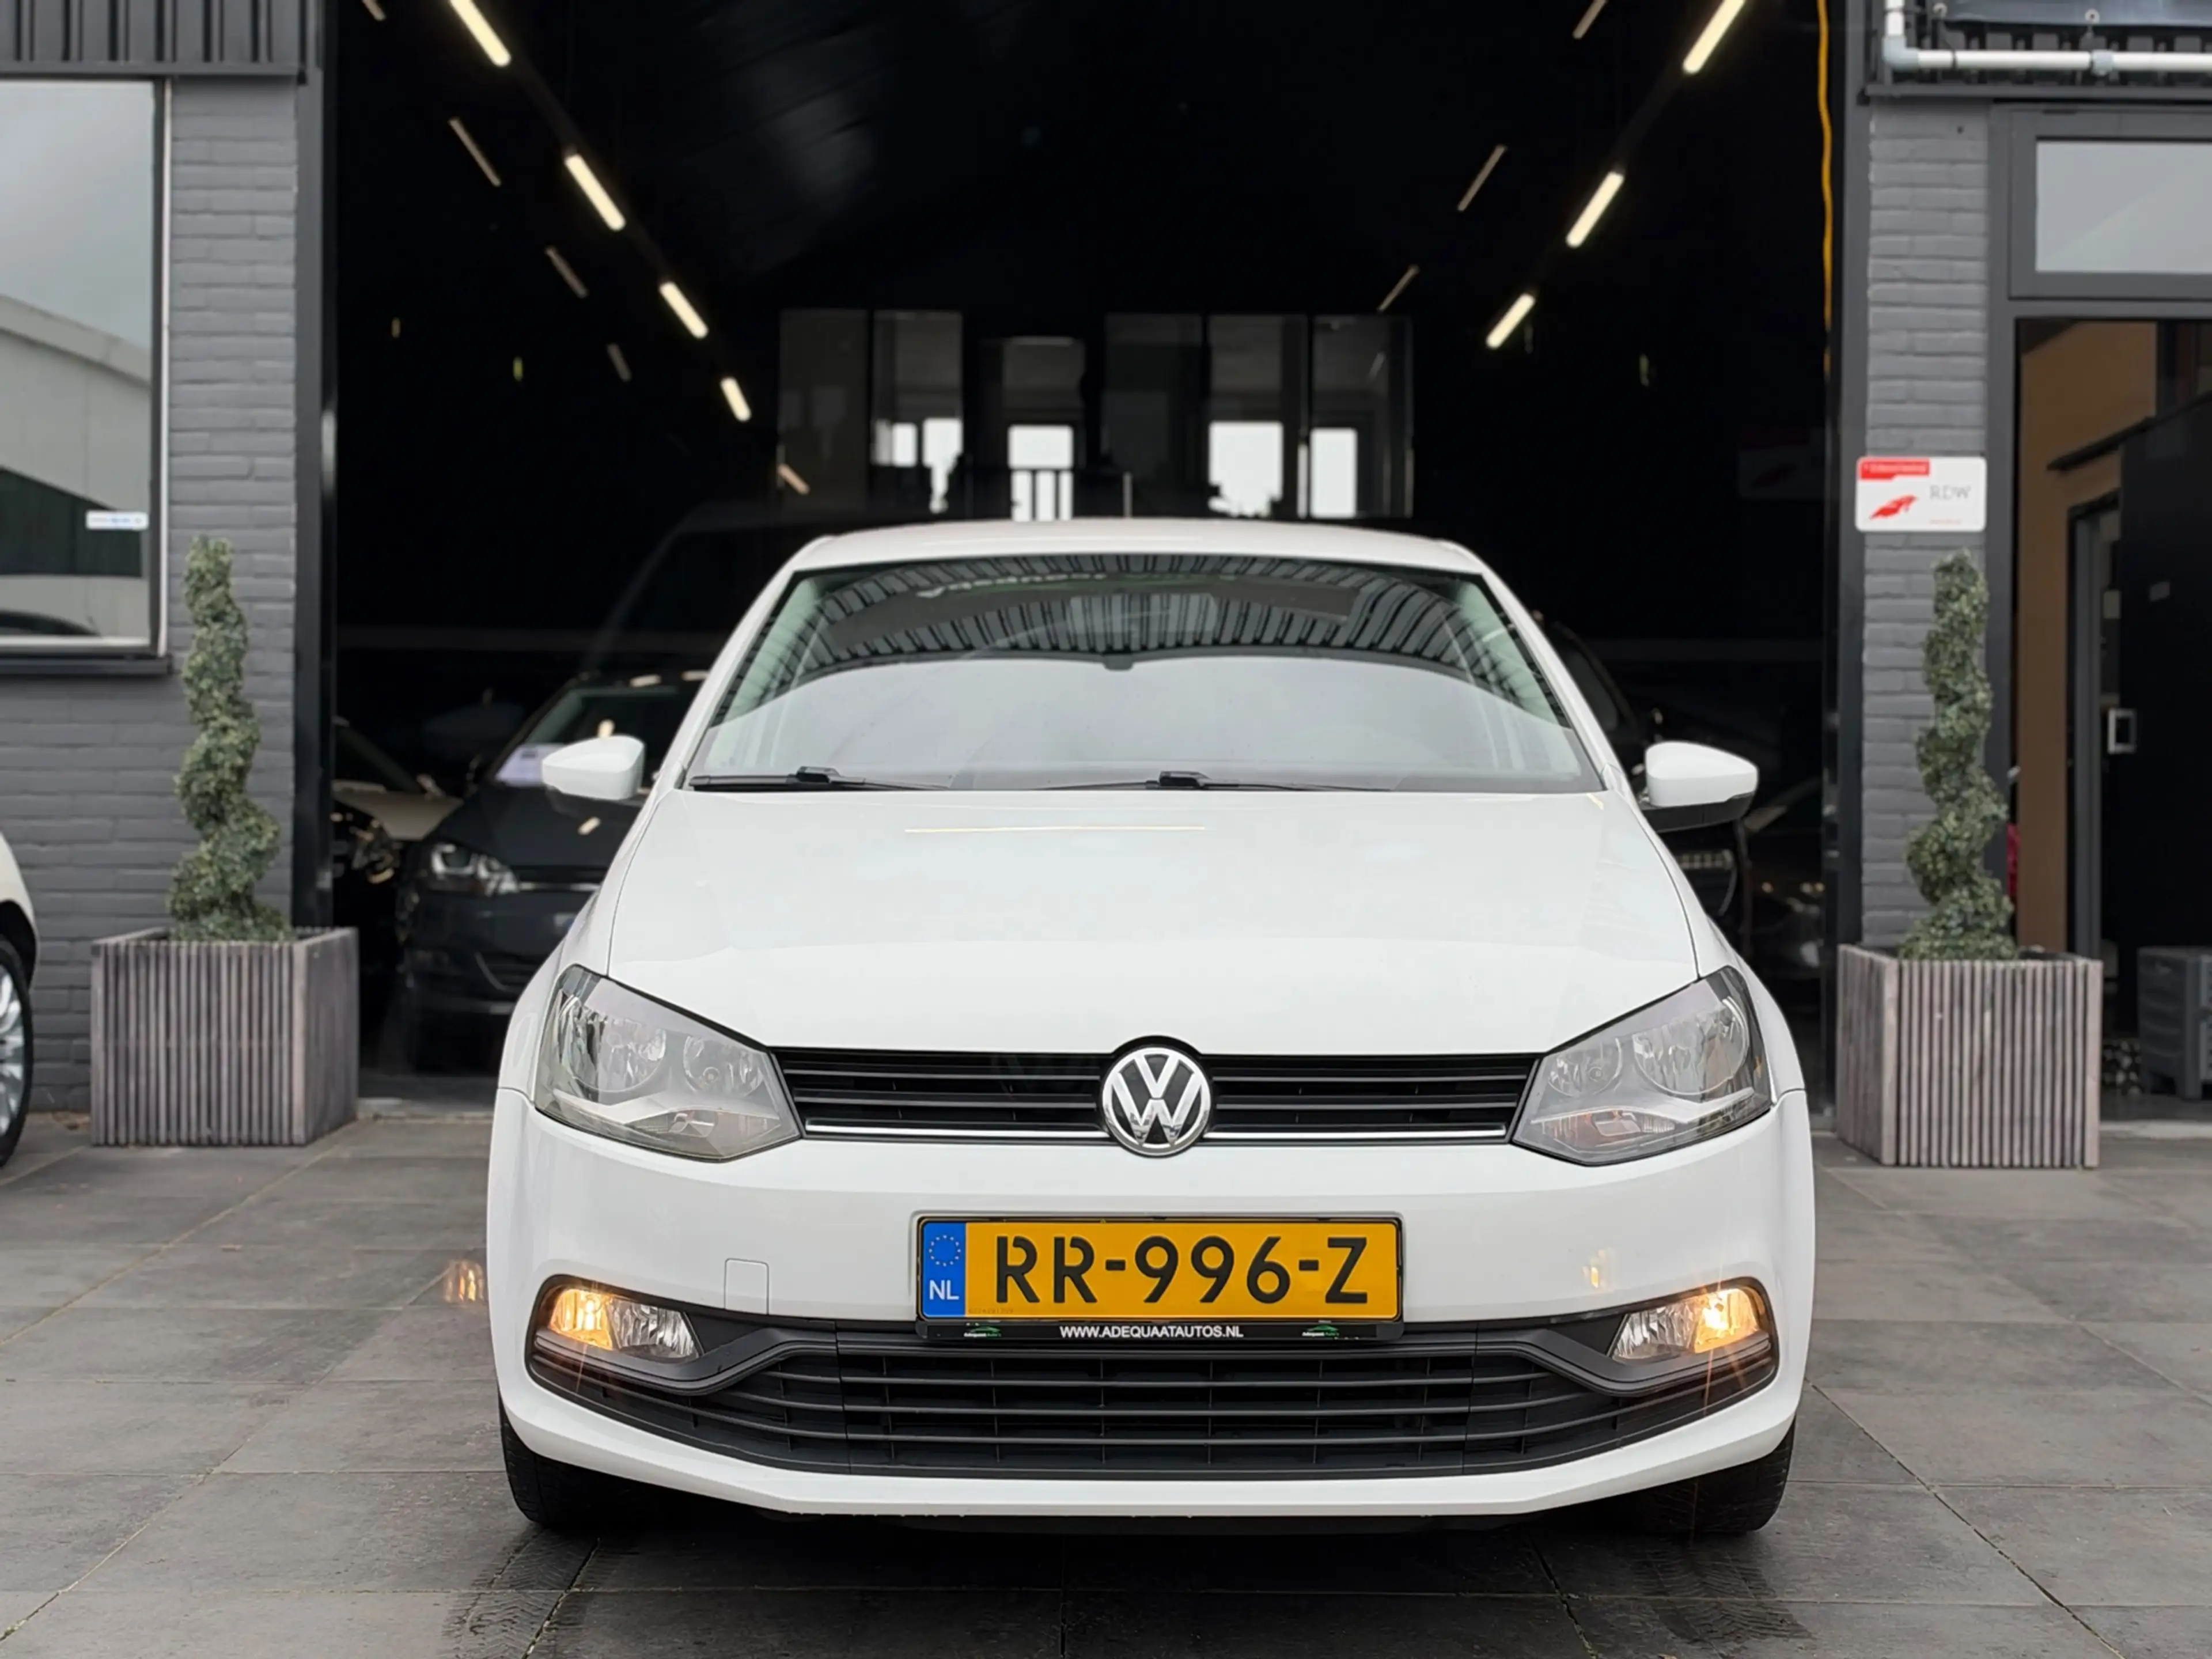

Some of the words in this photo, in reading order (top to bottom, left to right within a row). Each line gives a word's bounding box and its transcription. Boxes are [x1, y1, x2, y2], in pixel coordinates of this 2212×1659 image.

[996, 1236, 1368, 1304] RR-996-Z
[929, 1279, 960, 1300] NL
[1059, 1325, 1244, 1338] WWW.ADEQUAATAUTOS.NL
